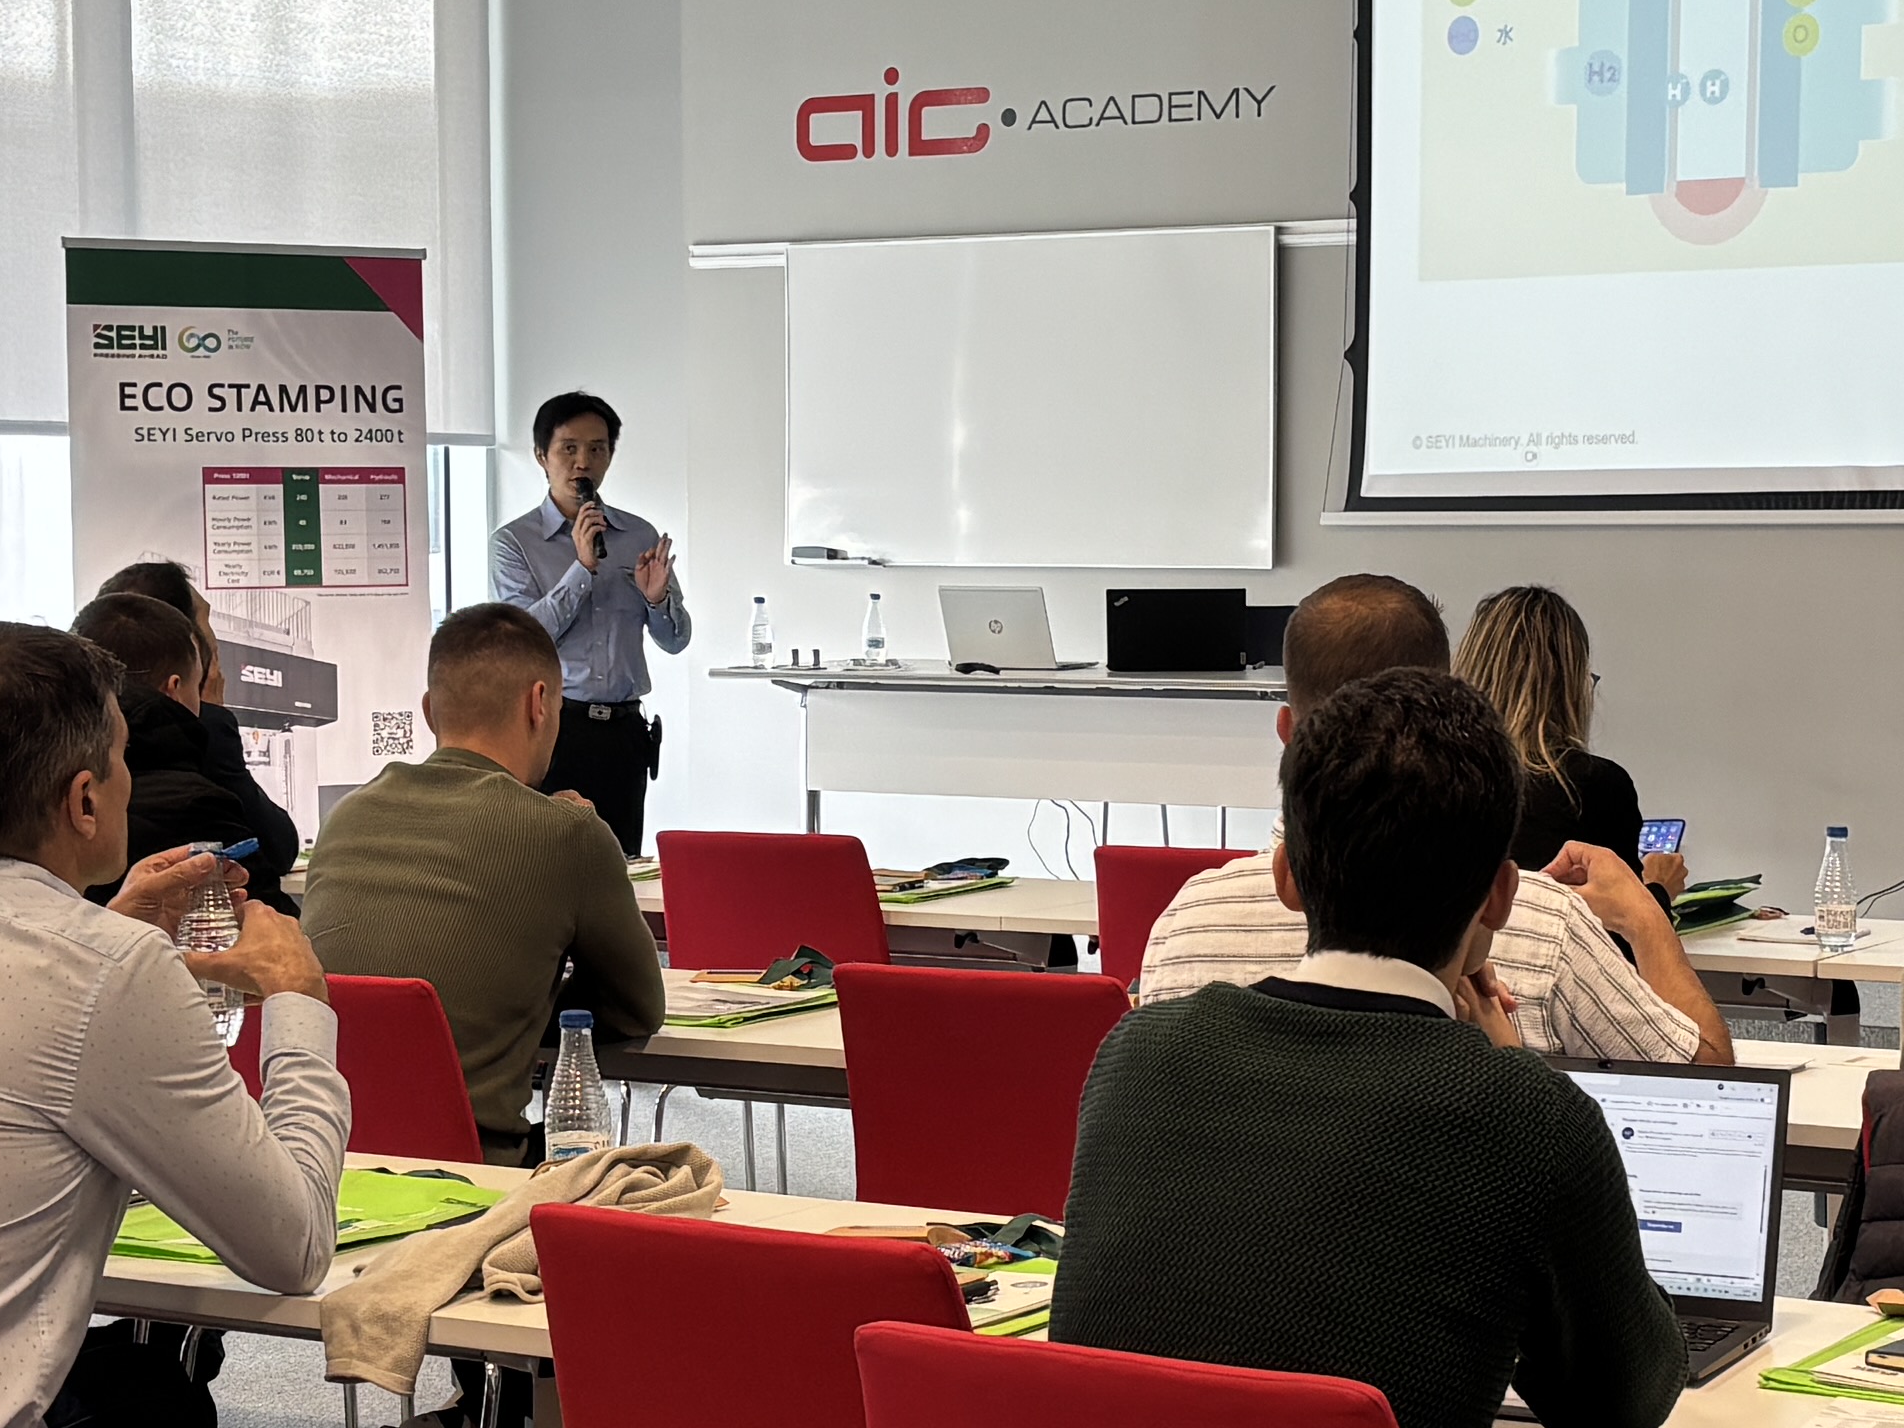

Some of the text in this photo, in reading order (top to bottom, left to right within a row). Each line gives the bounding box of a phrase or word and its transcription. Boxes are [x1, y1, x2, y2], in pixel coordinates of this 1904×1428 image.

[1496, 24, 1514, 46] 水
[1026, 85, 1276, 131] ACADEMY
[93, 324, 167, 351] SEYI
[118, 382, 404, 414] ECO STAMPING
[134, 428, 177, 443] SEYI
[184, 428, 235, 443] Servo
[242, 428, 289, 443] Press
[330, 430, 347, 443] to
[1426, 434, 1455, 449] SEYI
[1459, 433, 1523, 451] Machinery.
[1526, 431, 1542, 447] All
[1546, 431, 1578, 449] rights
[1582, 430, 1638, 446] reserved.
[240, 664, 282, 687] SEYI
